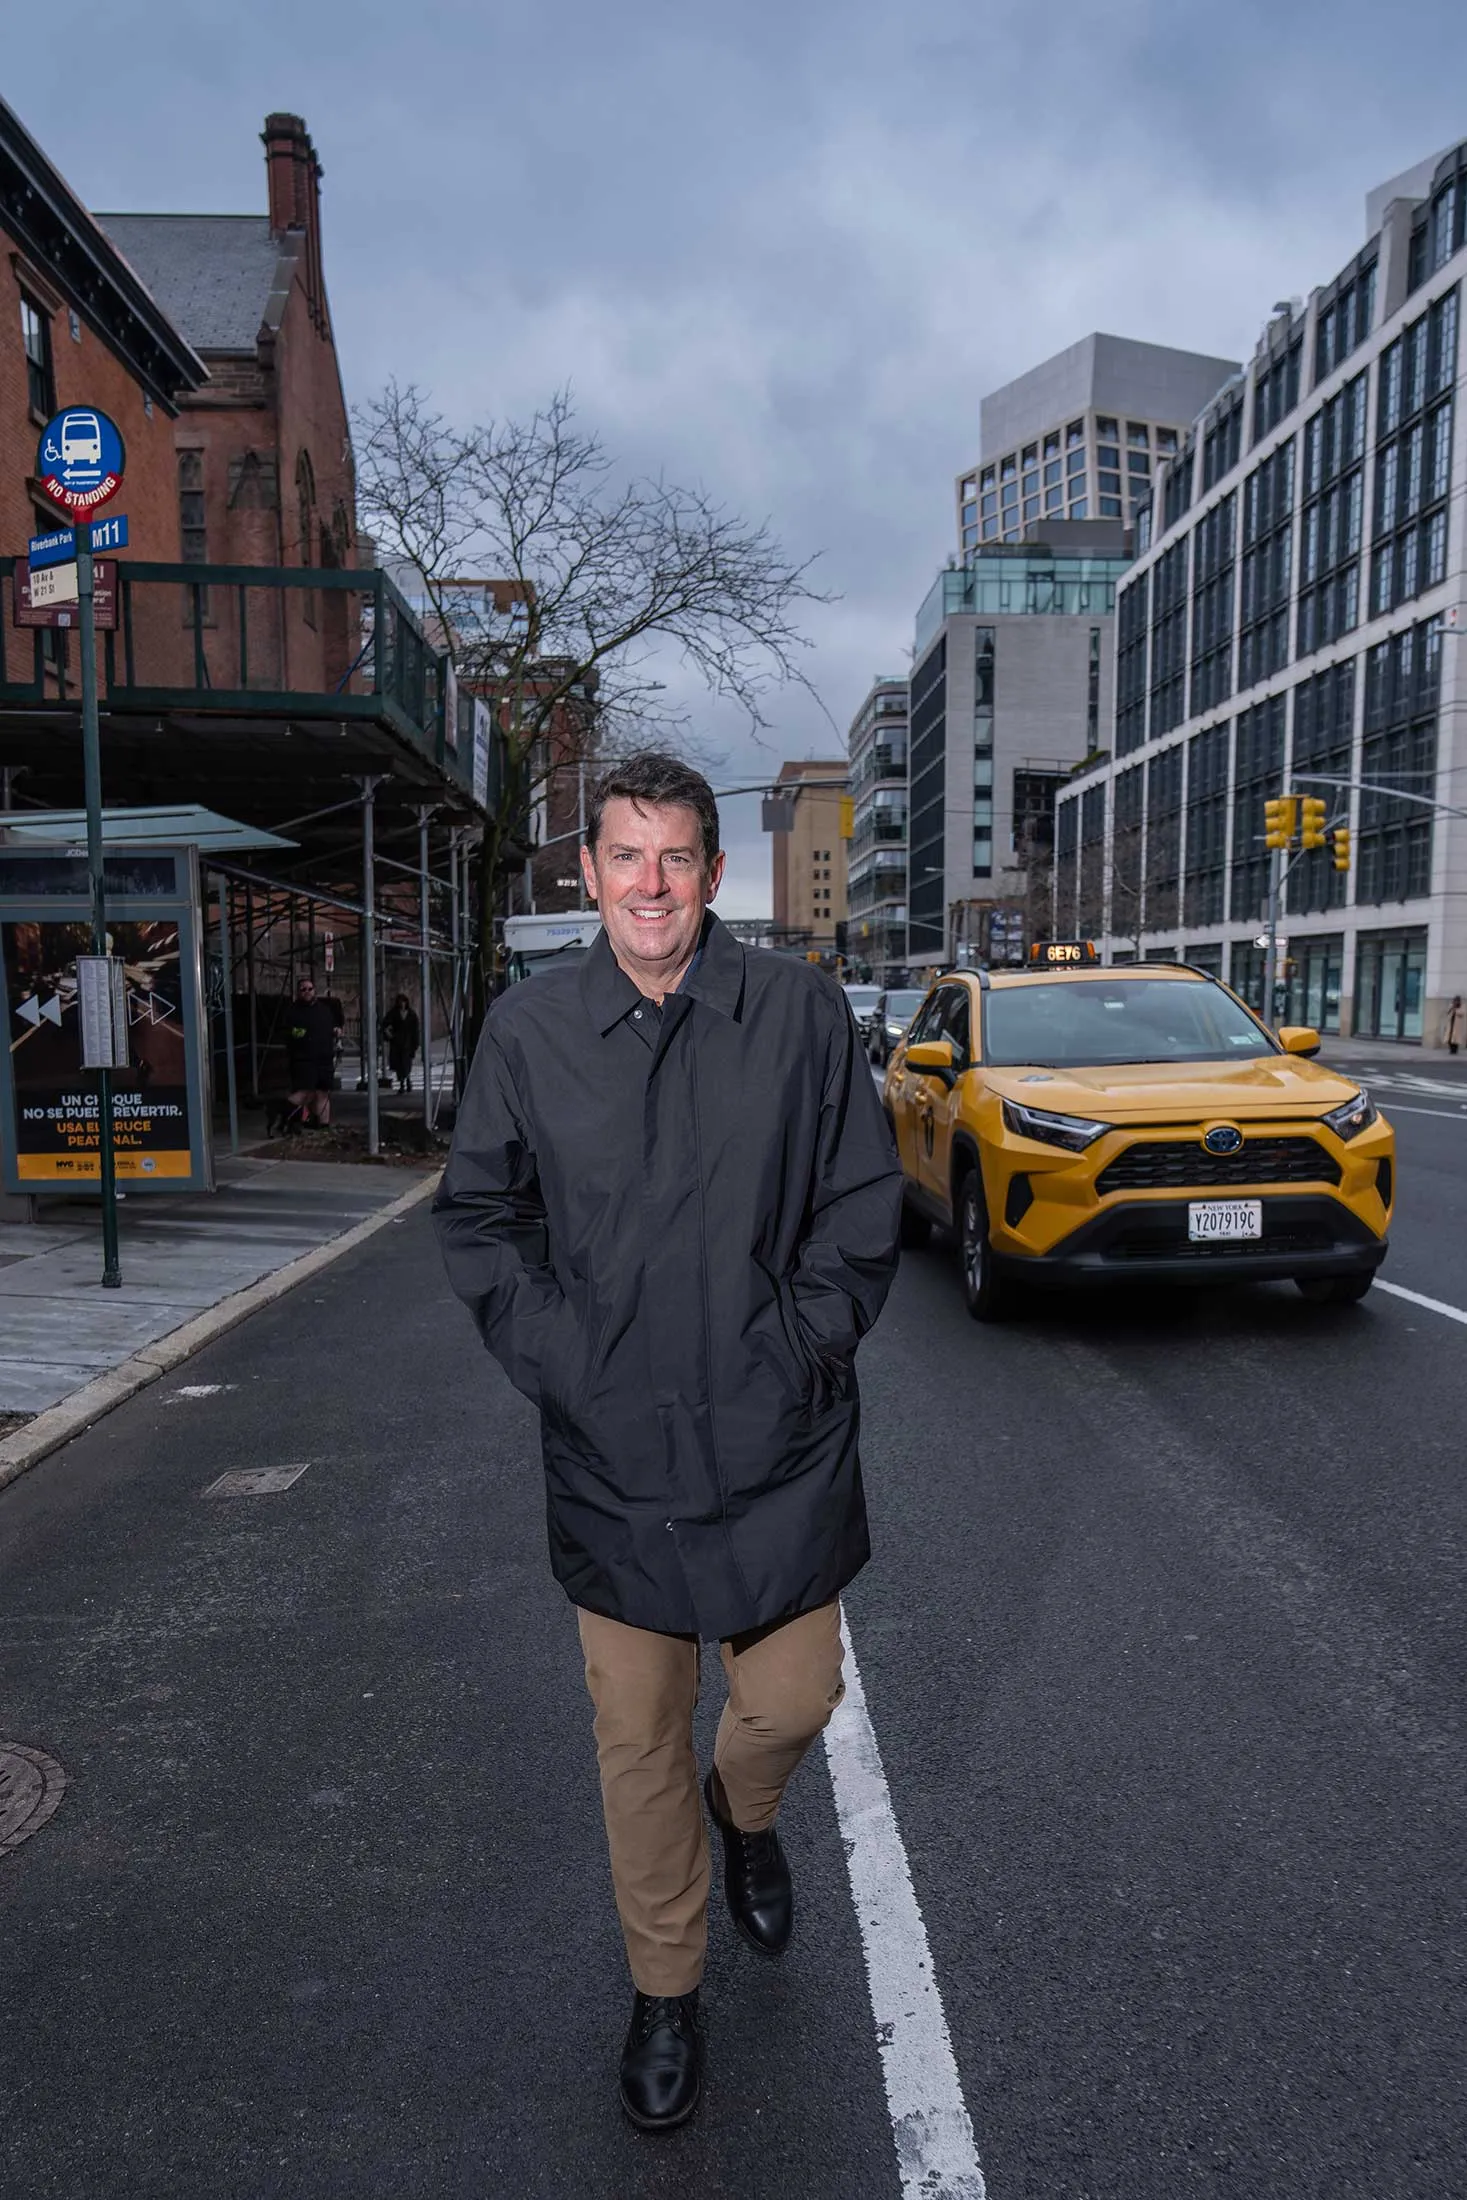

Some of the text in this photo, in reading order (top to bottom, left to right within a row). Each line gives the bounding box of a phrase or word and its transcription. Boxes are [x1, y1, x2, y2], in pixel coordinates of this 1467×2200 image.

[47, 476, 117, 506] NO STANDING
[31, 531, 73, 552] Riverbank Park
[92, 520, 119, 549] M11
[1047, 945, 1081, 961] 6E76
[62, 1094, 142, 1106] UN CHQUE
[24, 1105, 182, 1119] NO SE PUED REVERTIR.
[57, 1122, 84, 1133] USA
[113, 1120, 151, 1132] RUCE
[68, 1134, 142, 1146] PEATNAL.
[1208, 1204, 1223, 1212] NEW
[1196, 1210, 1255, 1232] Y207919C
